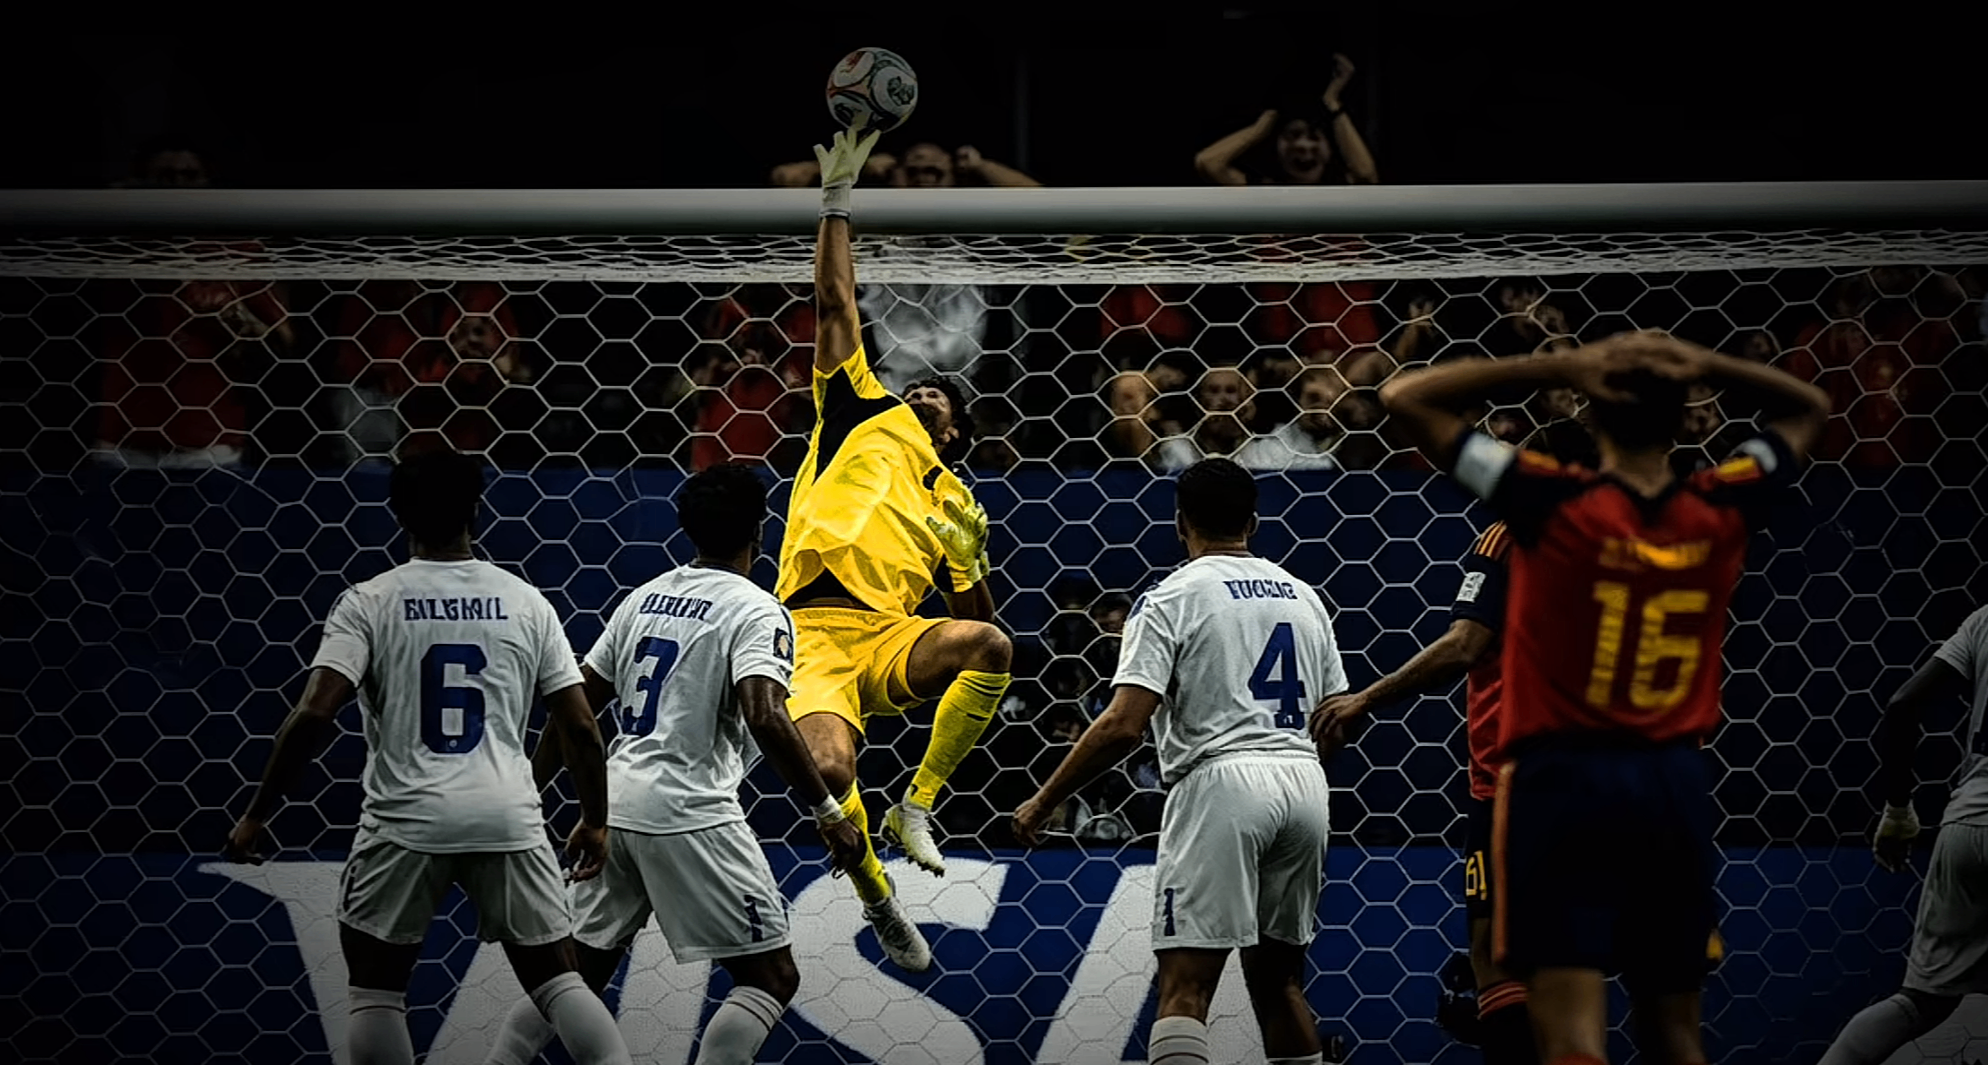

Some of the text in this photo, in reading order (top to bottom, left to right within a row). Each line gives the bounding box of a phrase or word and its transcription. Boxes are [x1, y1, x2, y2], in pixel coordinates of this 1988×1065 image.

[421, 643, 487, 753] 6
[622, 636, 679, 736] 3
[1248, 622, 1306, 730] 4
[1585, 579, 1711, 710] 16
